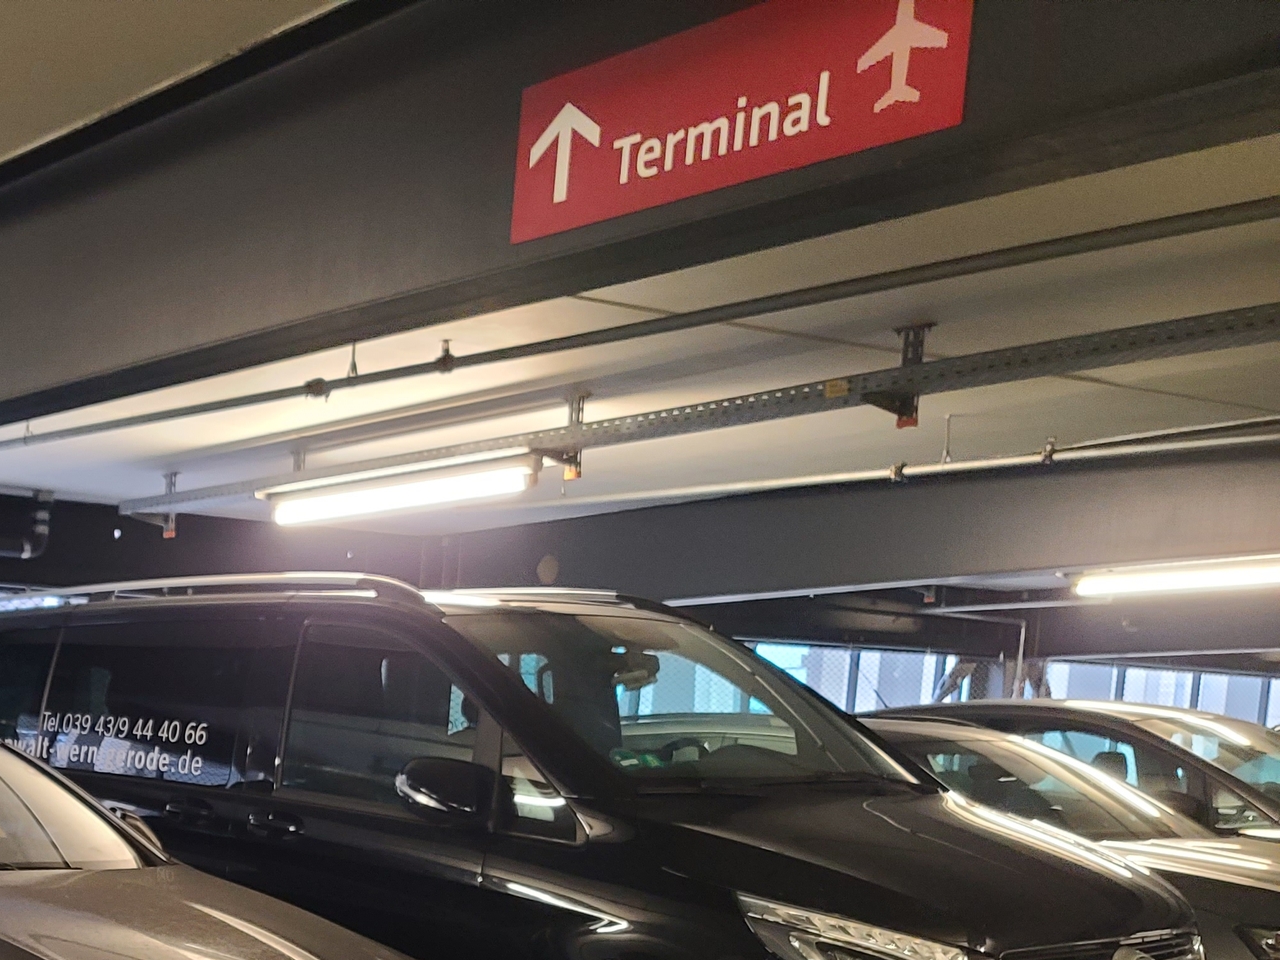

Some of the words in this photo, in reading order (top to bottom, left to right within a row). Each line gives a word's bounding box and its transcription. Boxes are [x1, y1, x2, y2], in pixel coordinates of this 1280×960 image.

[613, 71, 831, 185] Terminal
[94, 716, 129, 738] 43/9
[132, 718, 153, 740] 44
[158, 720, 180, 743] 40
[184, 722, 208, 745] 66
